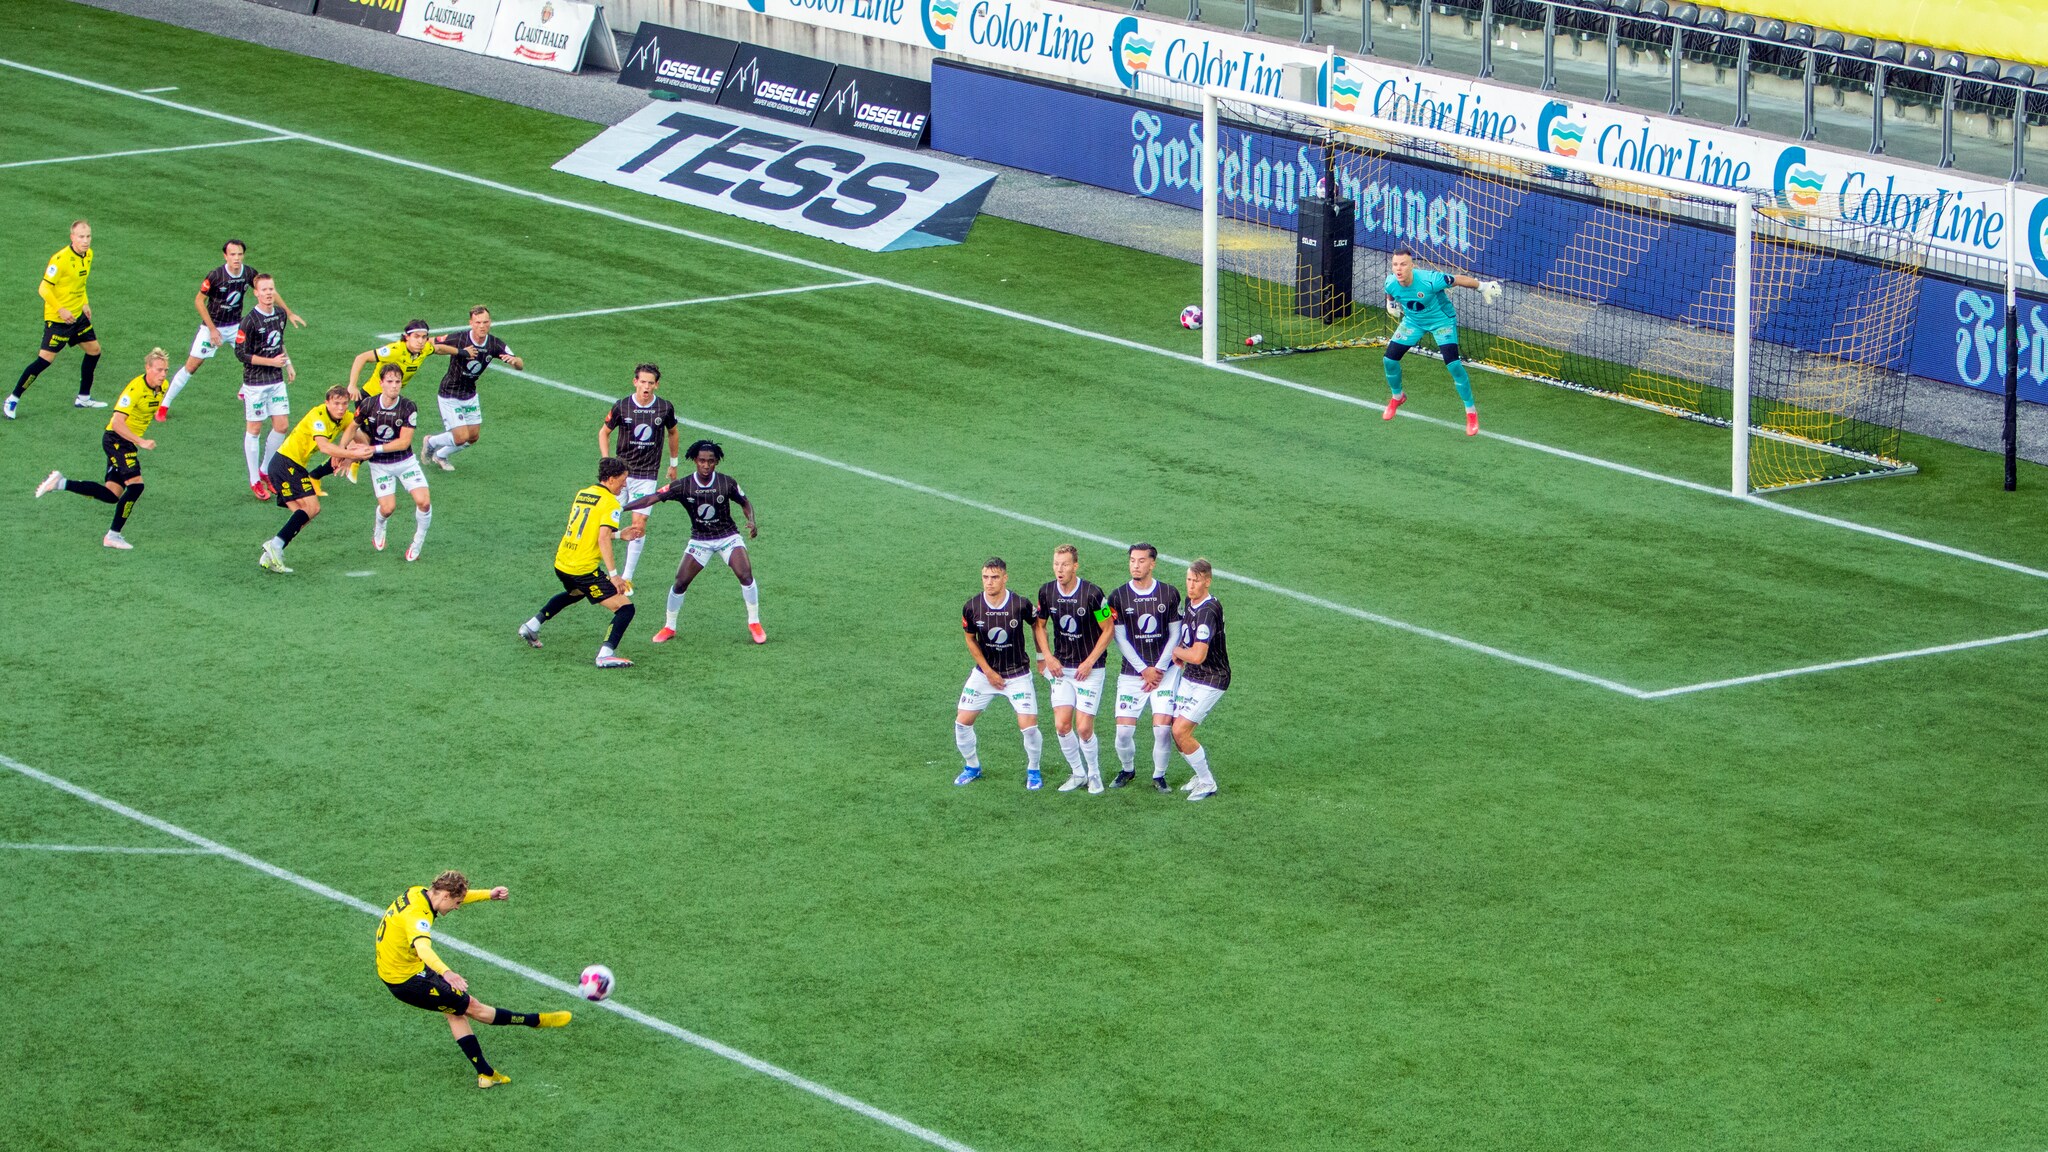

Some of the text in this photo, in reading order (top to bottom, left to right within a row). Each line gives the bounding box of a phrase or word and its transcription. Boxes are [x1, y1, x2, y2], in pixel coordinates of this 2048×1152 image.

[423, 1, 476, 31] CLAUSTHALER
[514, 21, 570, 50] CLAUSTHALER
[969, 1, 1095, 65] Color Line
[1165, 38, 1284, 99] Color Lin
[1373, 79, 1453, 131] Color
[616, 111, 940, 230] TESS
[1597, 124, 1751, 188] Color Line
[1838, 171, 2005, 250] Color Line
[566, 505, 591, 540] 21
[1101, 607, 1110, 618] C
